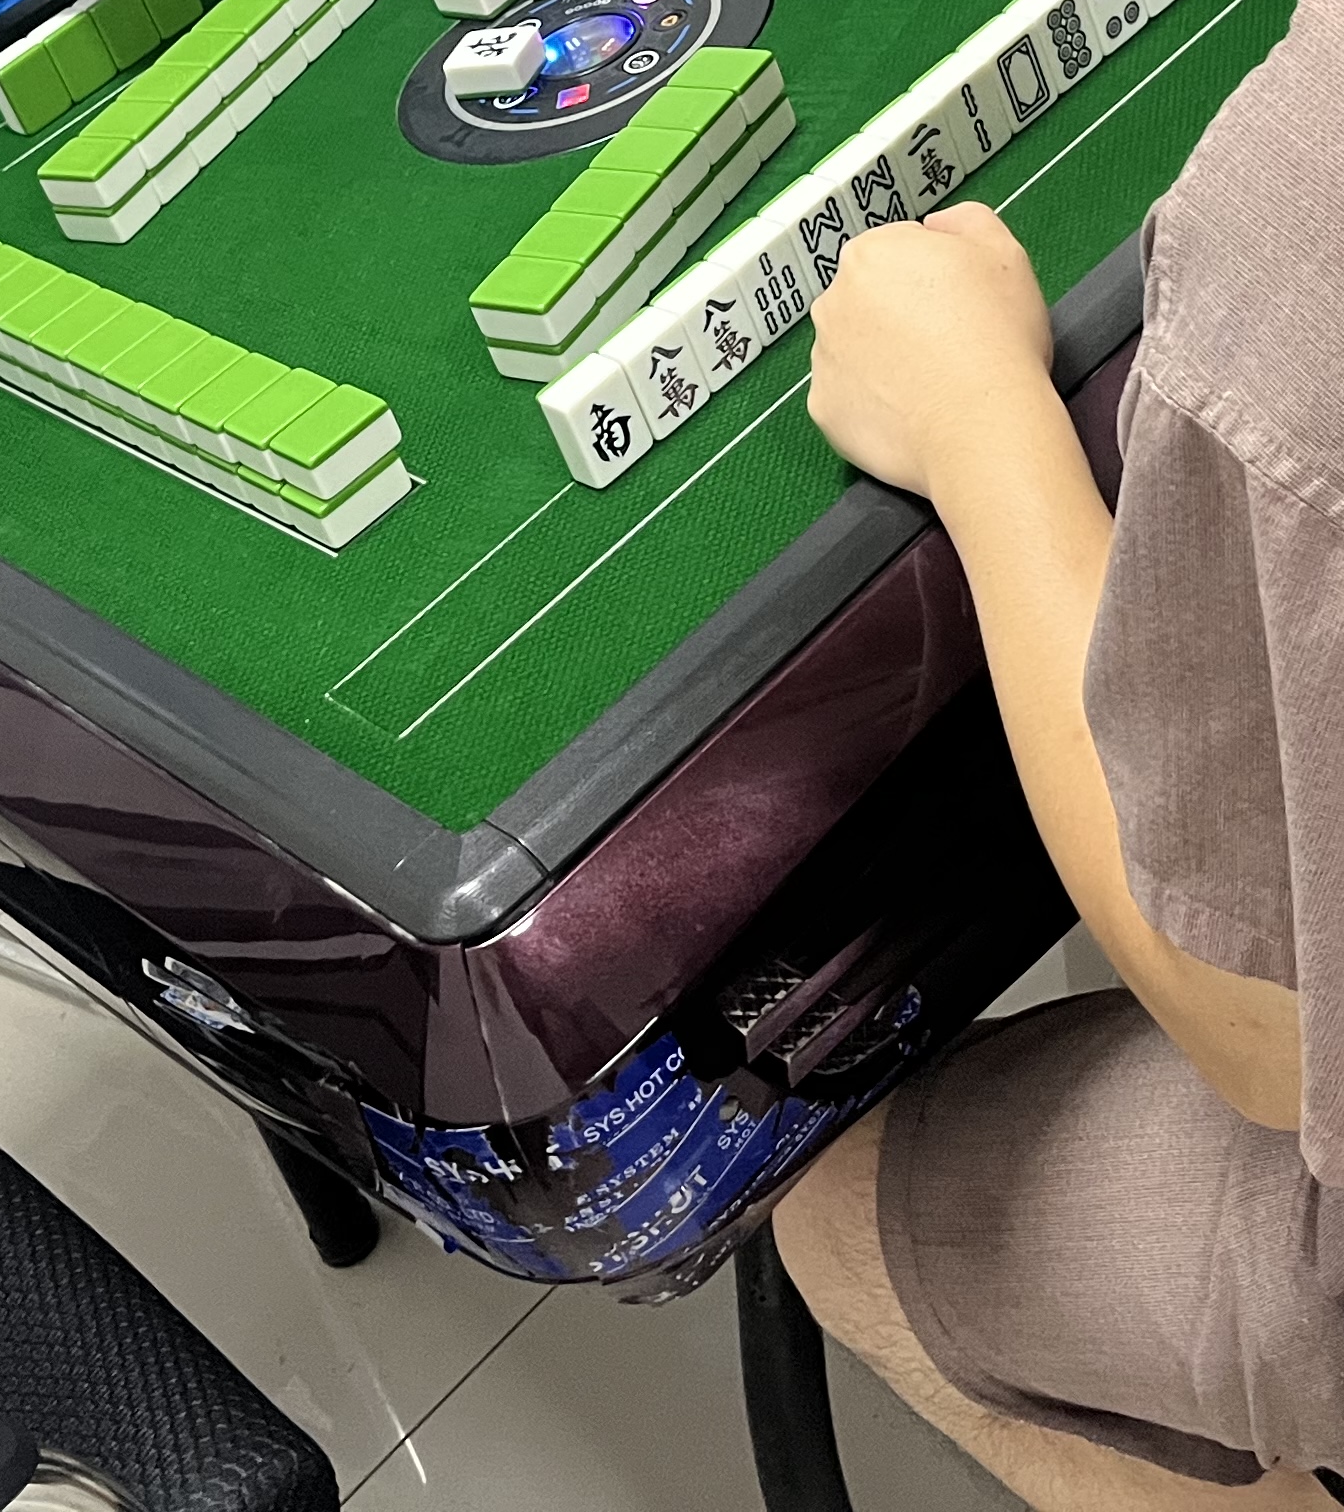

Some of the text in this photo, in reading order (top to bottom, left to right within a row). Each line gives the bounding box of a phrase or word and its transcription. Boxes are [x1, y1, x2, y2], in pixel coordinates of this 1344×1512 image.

[907, 123, 956, 197] 二萬
[702, 298, 752, 372] 八萬
[648, 345, 699, 420] 八萬
[589, 403, 632, 462] 南
[583, 1106, 626, 1144] SYS
[625, 1067, 664, 1113] HOT
[717, 1107, 750, 1150] SYS
[595, 1127, 679, 1195] SYSTEM
